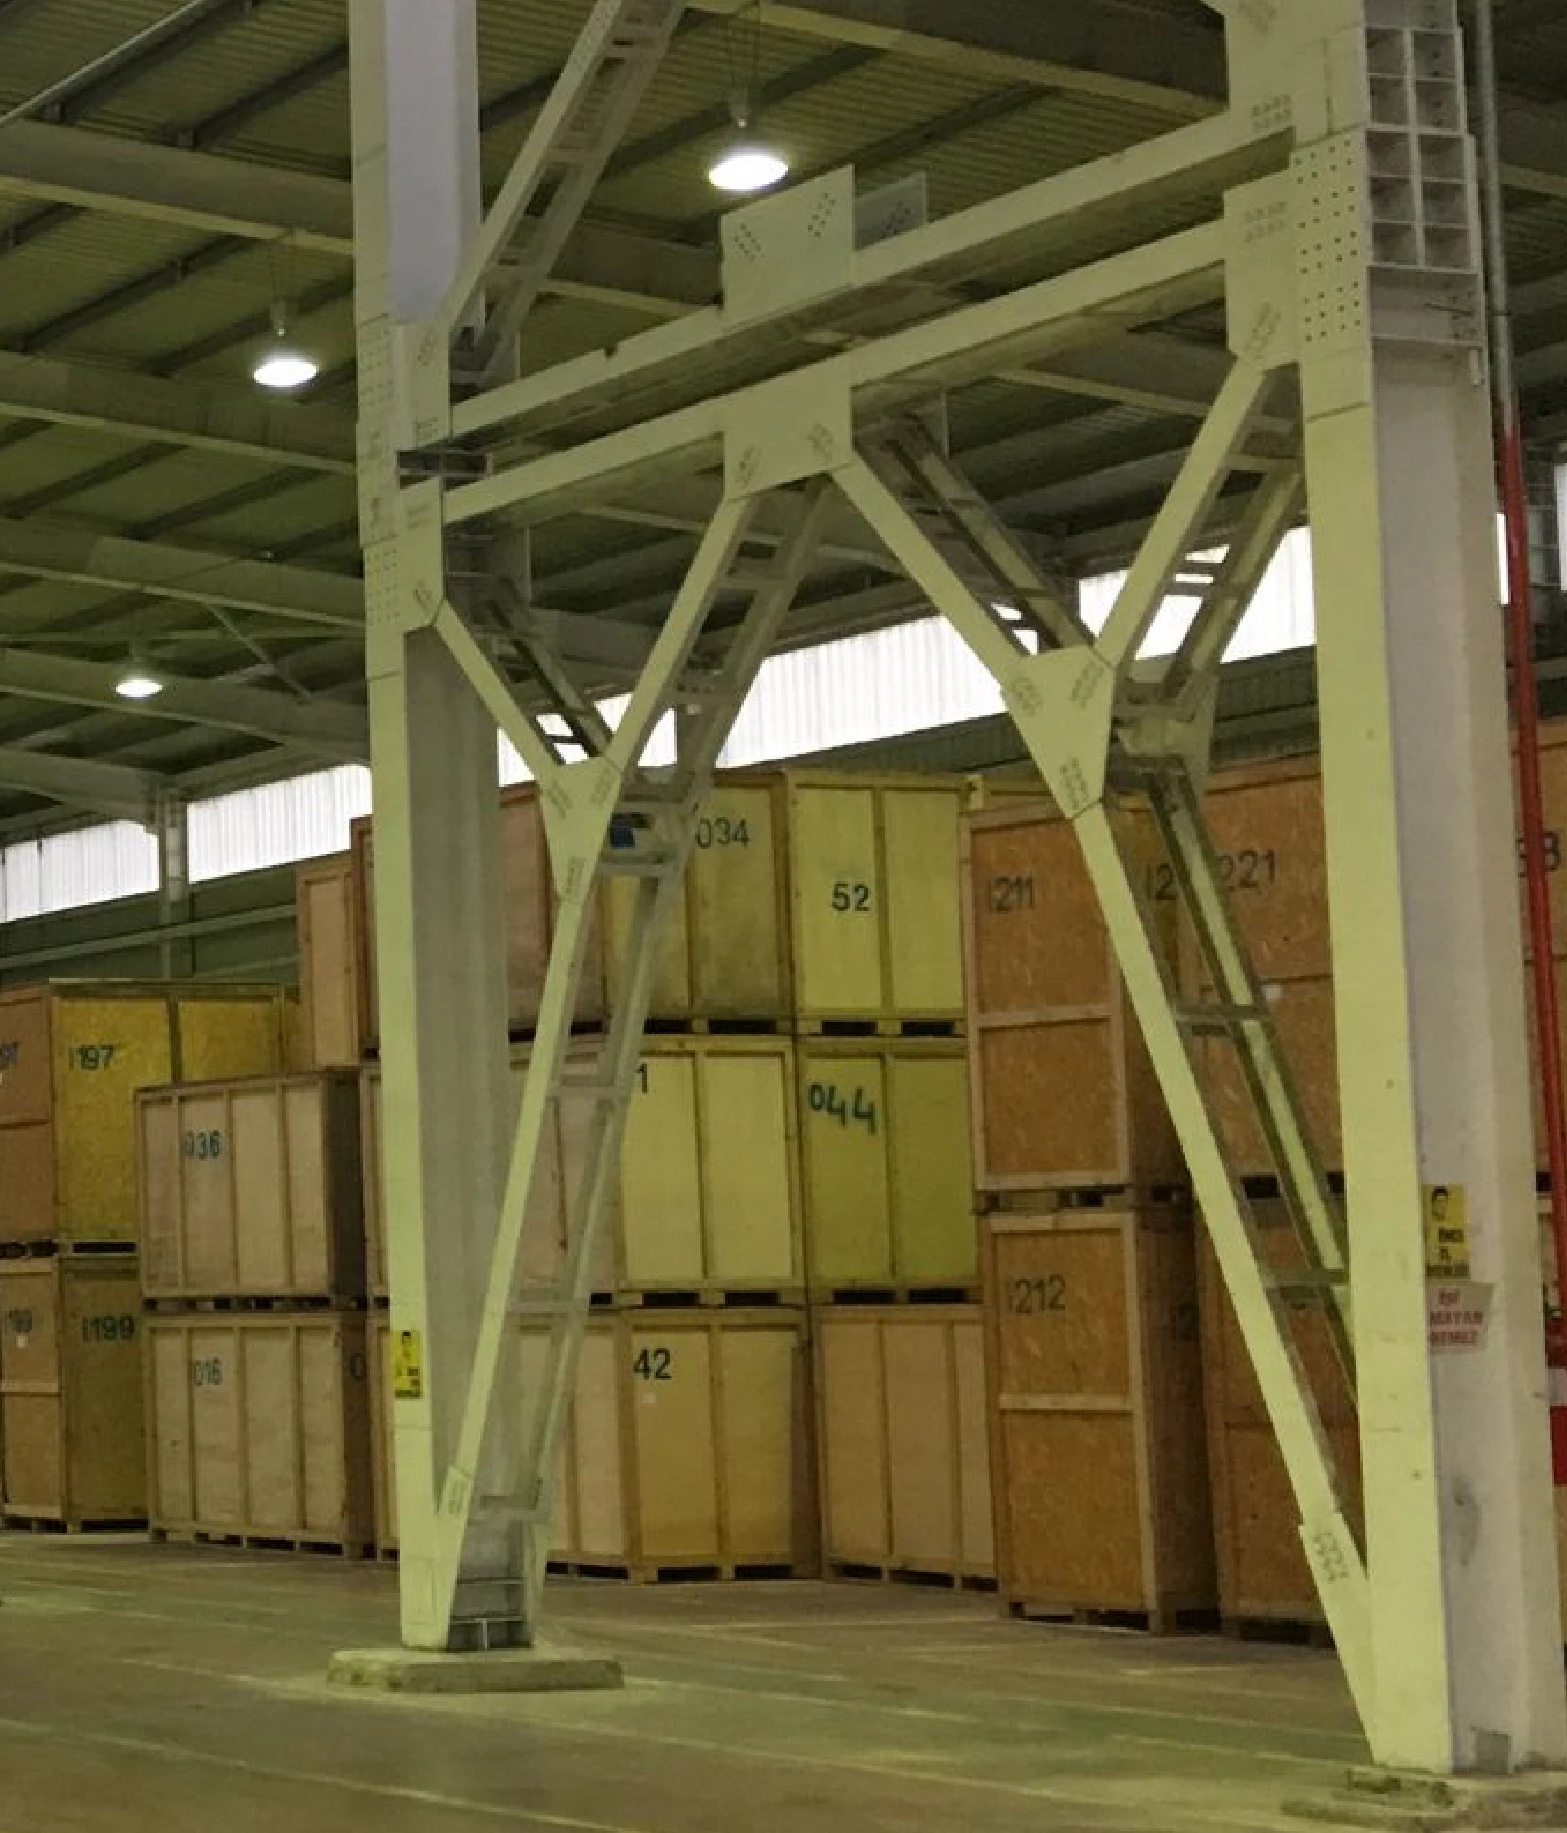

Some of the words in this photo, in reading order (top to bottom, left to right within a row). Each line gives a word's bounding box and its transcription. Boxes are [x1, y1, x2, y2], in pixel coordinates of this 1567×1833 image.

[830, 883, 872, 912] 52
[807, 1083, 877, 1134] 044
[633, 1348, 672, 1381] 42
